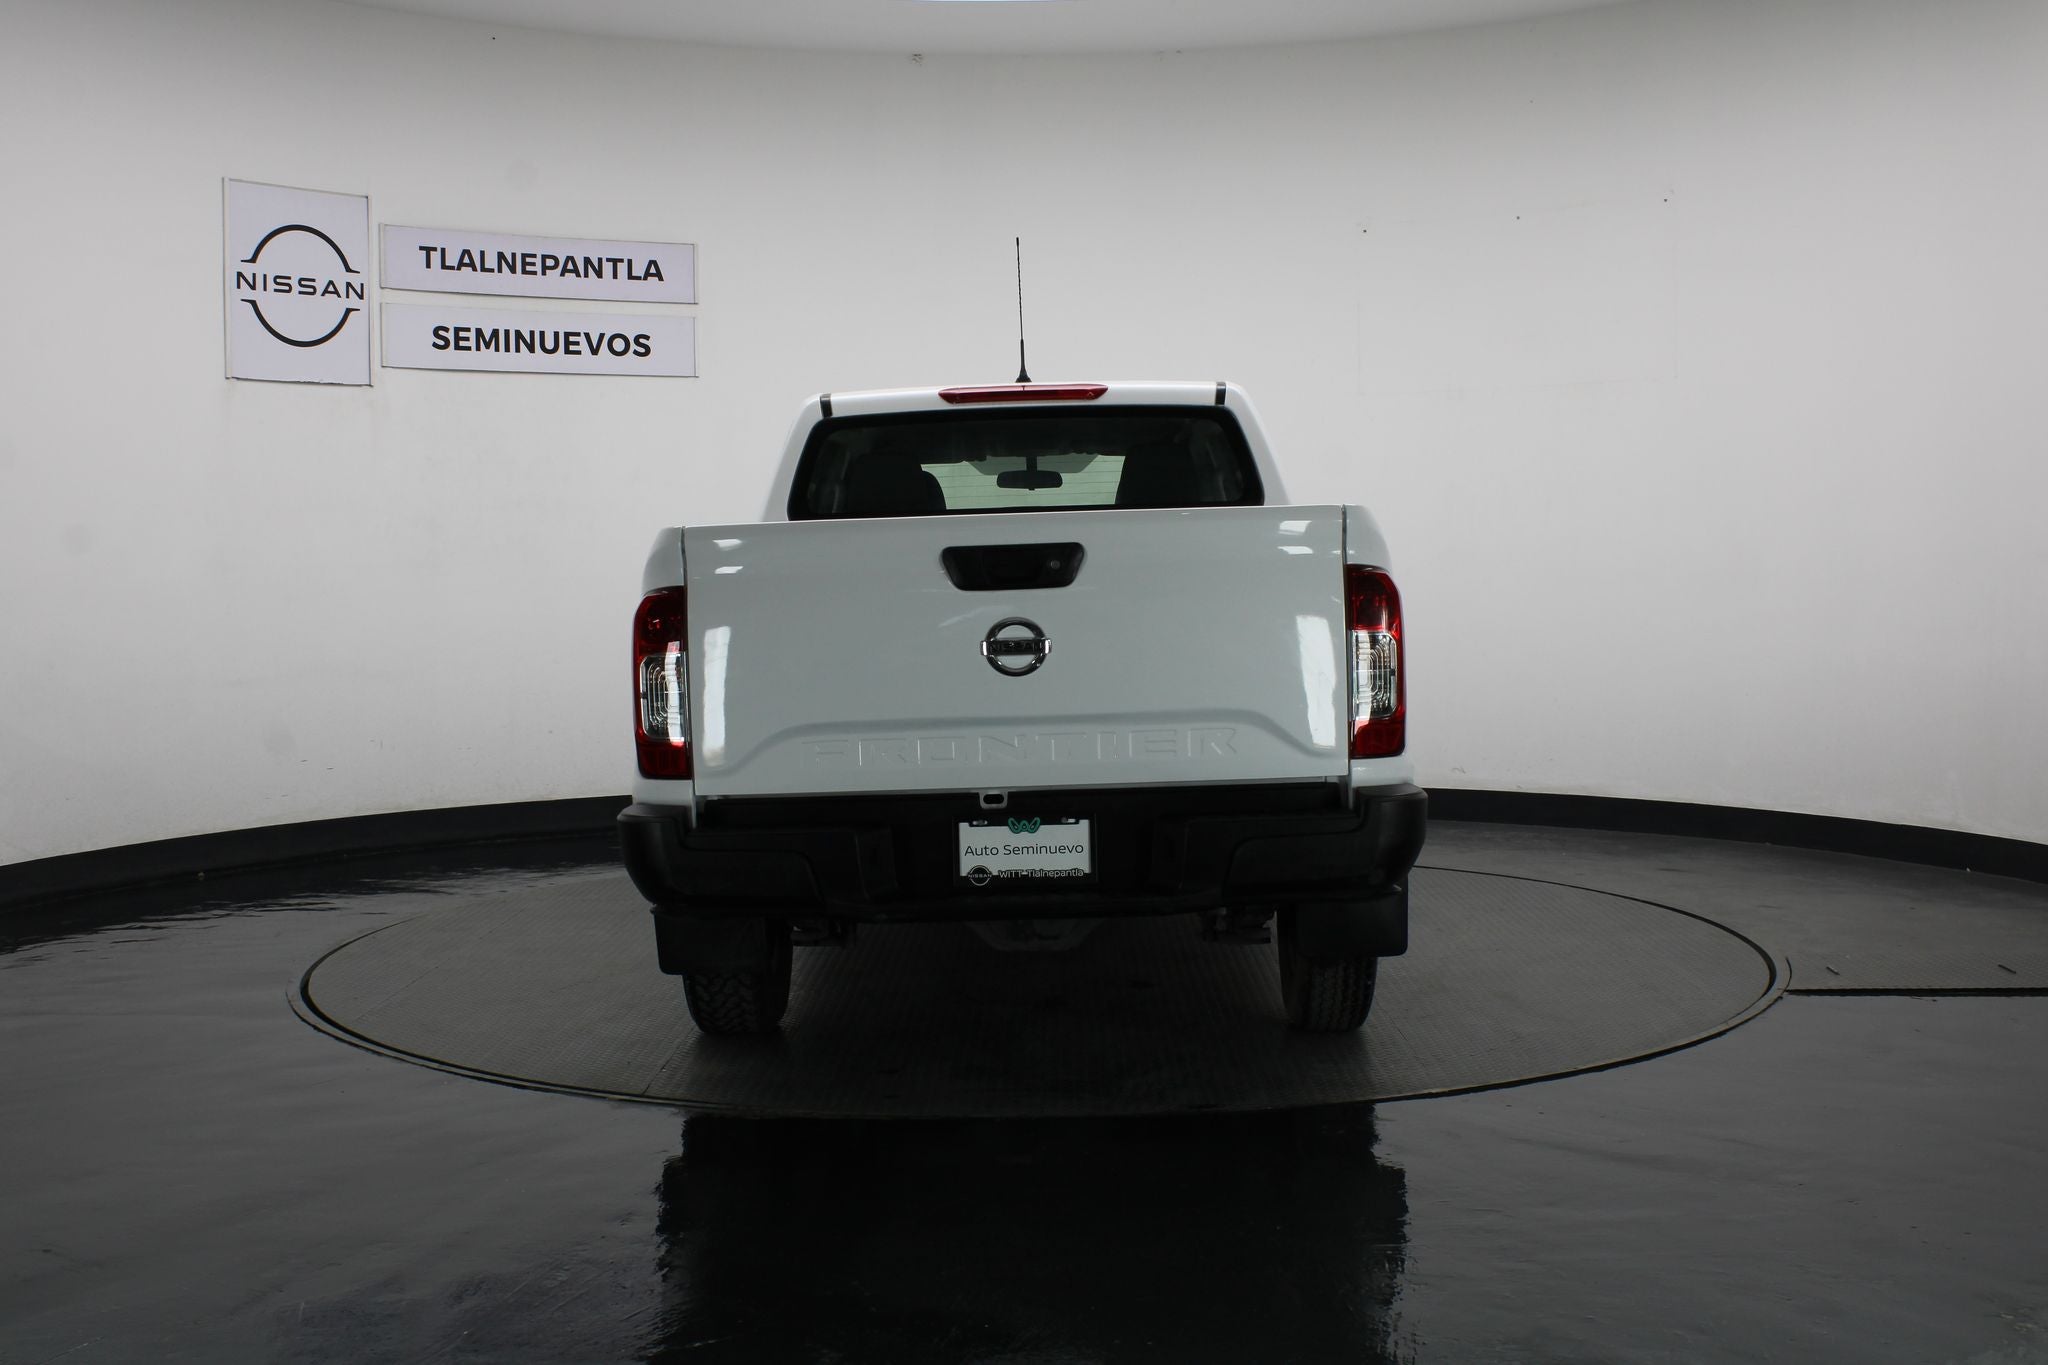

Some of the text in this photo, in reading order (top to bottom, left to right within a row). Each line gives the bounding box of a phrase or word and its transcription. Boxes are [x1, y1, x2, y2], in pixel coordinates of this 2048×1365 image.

[418, 246, 664, 282] TLALNEPANTLA
[236, 270, 365, 300] NISSAN
[431, 325, 652, 358] SEMINUEVOS
[801, 727, 1238, 768] FRONTIER
[964, 844, 1084, 856] Auto Seminuevo
